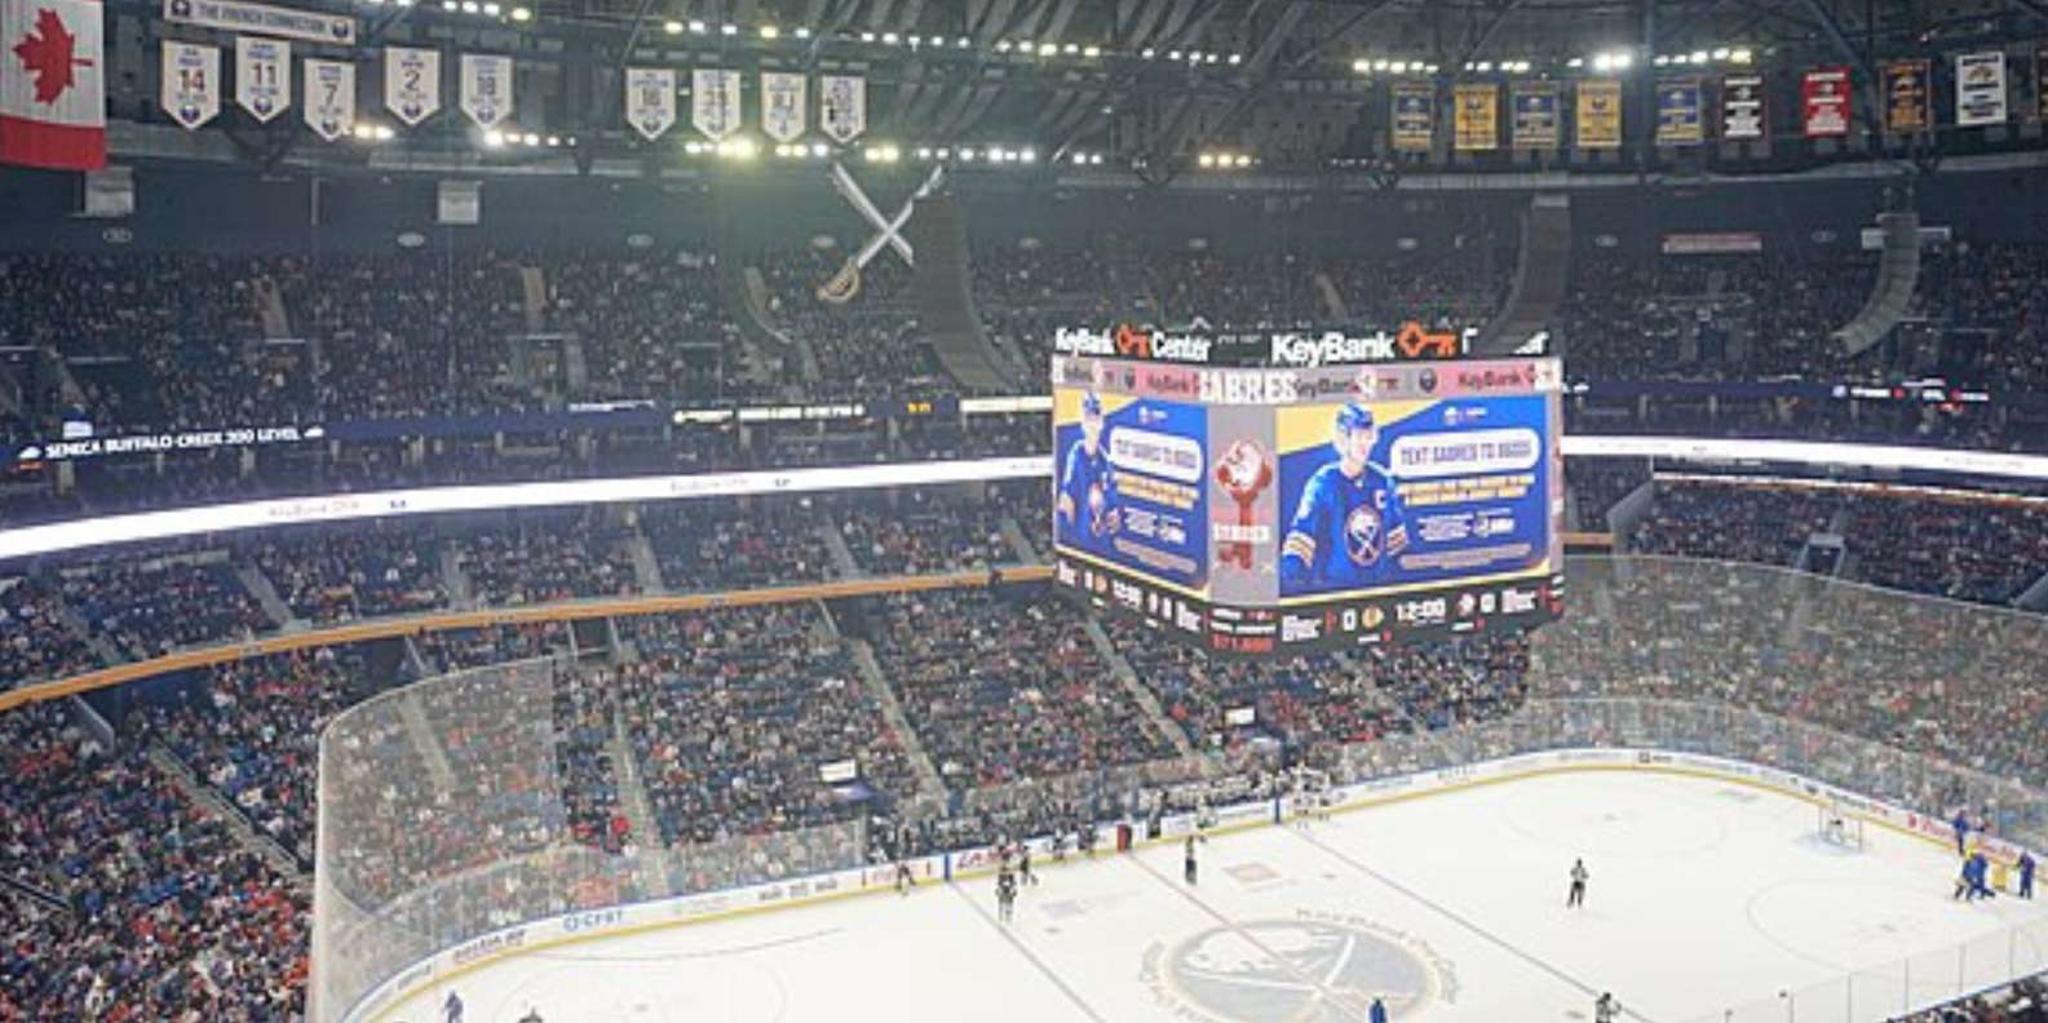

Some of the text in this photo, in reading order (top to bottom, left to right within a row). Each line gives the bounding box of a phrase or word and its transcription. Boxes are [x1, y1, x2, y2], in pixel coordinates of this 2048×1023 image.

[180, 68, 205, 92] 14
[252, 62, 277, 86] 11
[404, 69, 421, 92] 2
[325, 83, 338, 105] 7
[1056, 327, 1212, 362] KeyBank Center
[1271, 331, 1396, 368] KeyBank
[45, 440, 101, 459] SENECA
[1342, 608, 1357, 632] 0
[1396, 597, 1446, 622] 12:00
